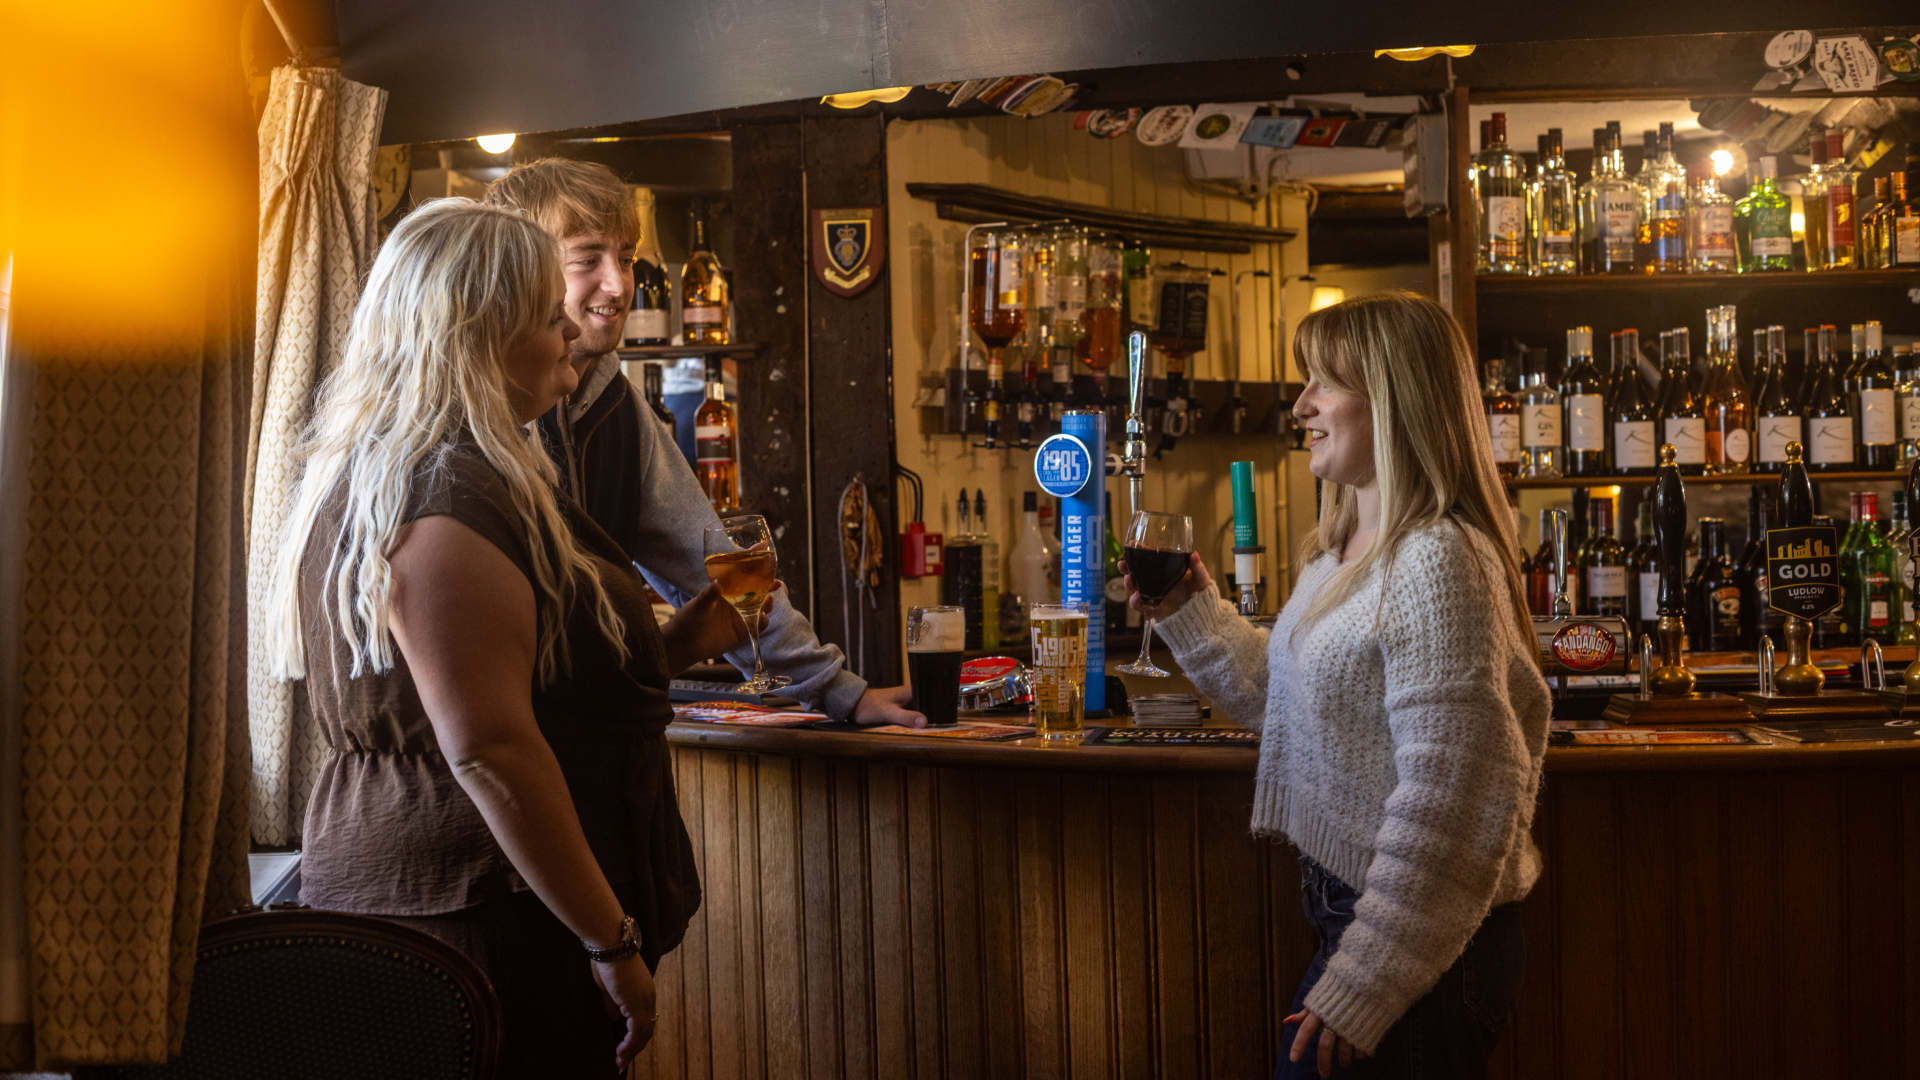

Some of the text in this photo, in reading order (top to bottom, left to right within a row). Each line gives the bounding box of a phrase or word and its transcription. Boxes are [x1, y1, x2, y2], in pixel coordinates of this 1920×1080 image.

[1823, 41, 1841, 89] PALE ALE
[1841, 40, 1860, 89] RARE BREED
[1042, 450, 1081, 481] 1985
[1067, 515, 1082, 563] LAGER
[1779, 563, 1831, 579] GOLD
[1788, 587, 1825, 597] LUDLOW
[1042, 637, 1077, 667] 1985
[1554, 634, 1613, 655] FANDANGO!
